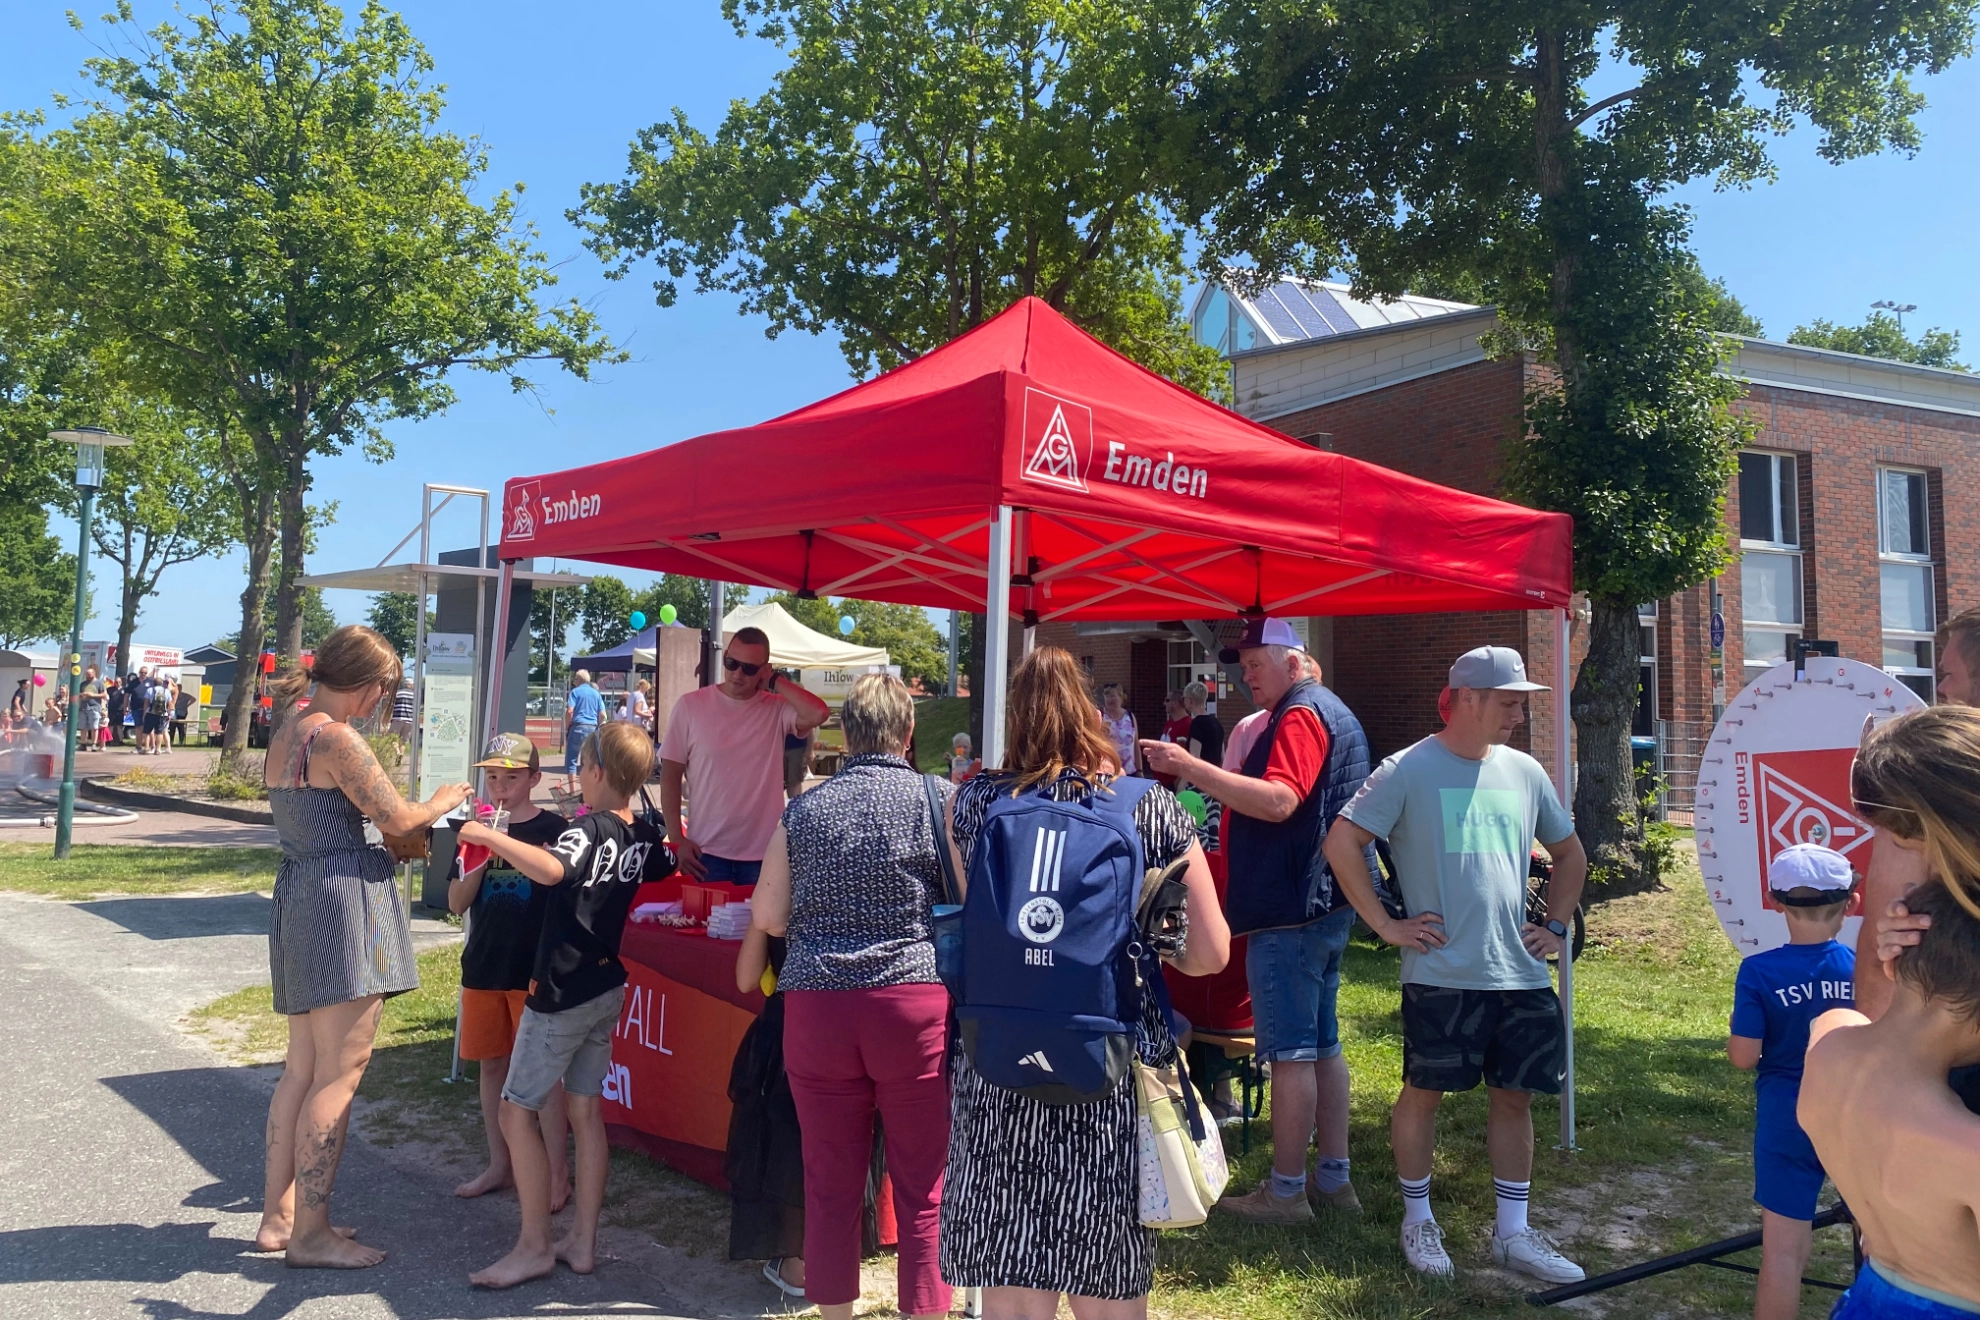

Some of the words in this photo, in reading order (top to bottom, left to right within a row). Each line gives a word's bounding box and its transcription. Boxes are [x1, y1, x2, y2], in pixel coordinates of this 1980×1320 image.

[1104, 441, 1208, 498] Emden
[541, 489, 601, 525] Emden
[824, 671, 854, 683] Ihlow
[488, 735, 519, 755] NY
[1734, 751, 1751, 824] Emden
[1455, 812, 1512, 829] HUGO
[1029, 906, 1055, 927] TSV
[1025, 948, 1055, 967] ABEL
[1775, 982, 1813, 1007] TSV
